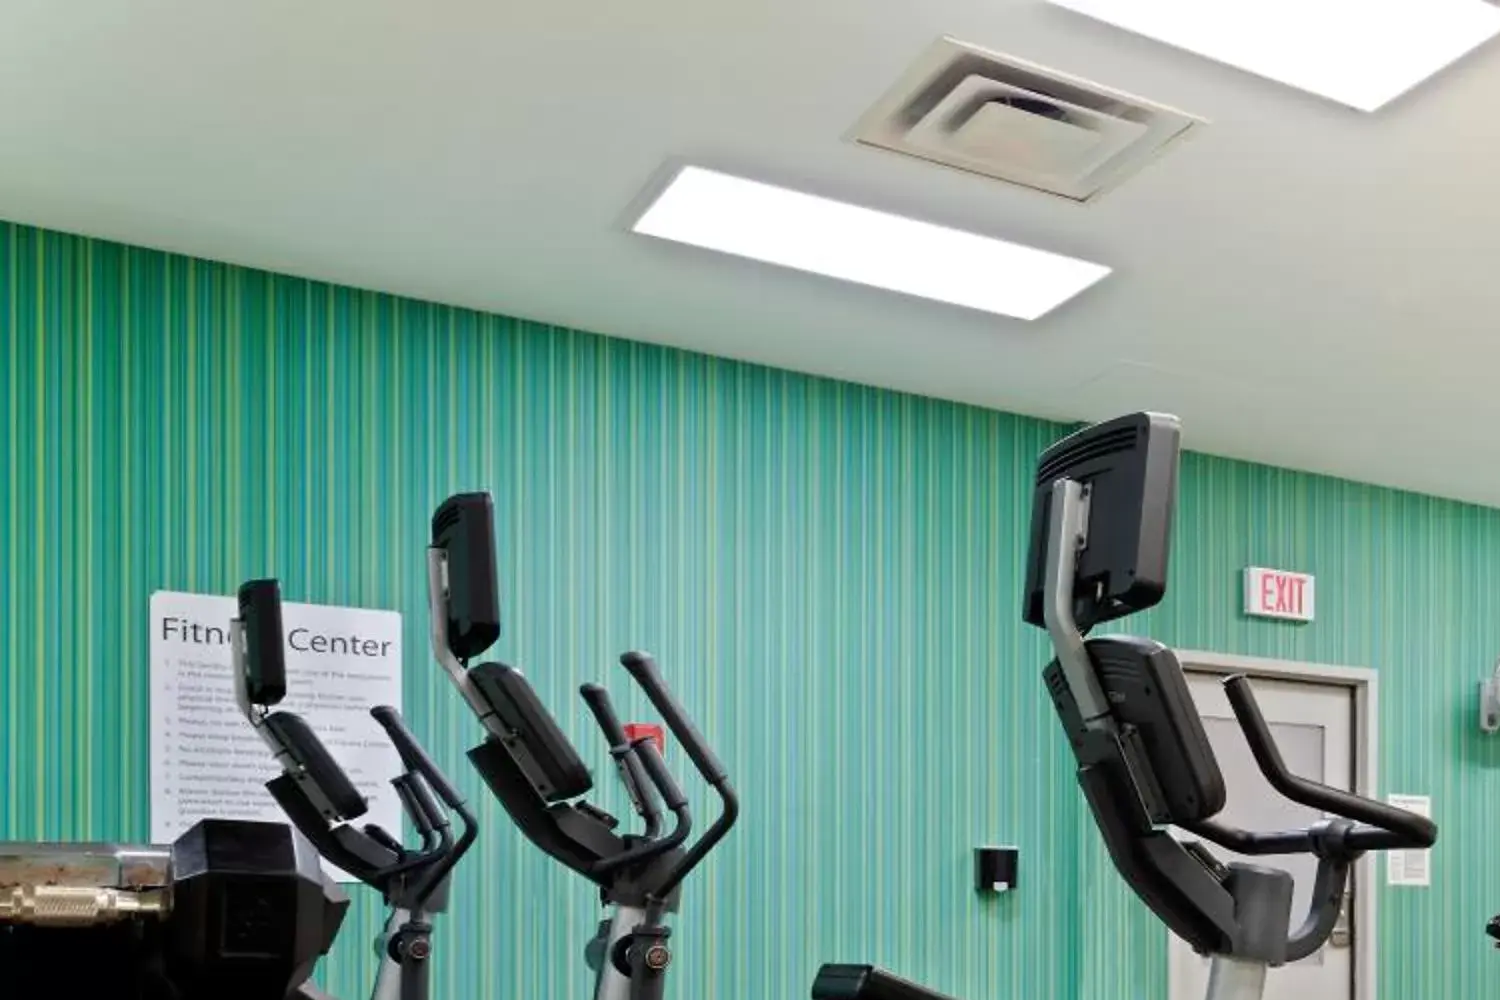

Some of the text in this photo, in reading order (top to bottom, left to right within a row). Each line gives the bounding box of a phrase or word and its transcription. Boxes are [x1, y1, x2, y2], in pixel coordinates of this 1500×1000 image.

[1262, 573, 1308, 615] EXIT
[162, 617, 392, 657] Fitn Center
